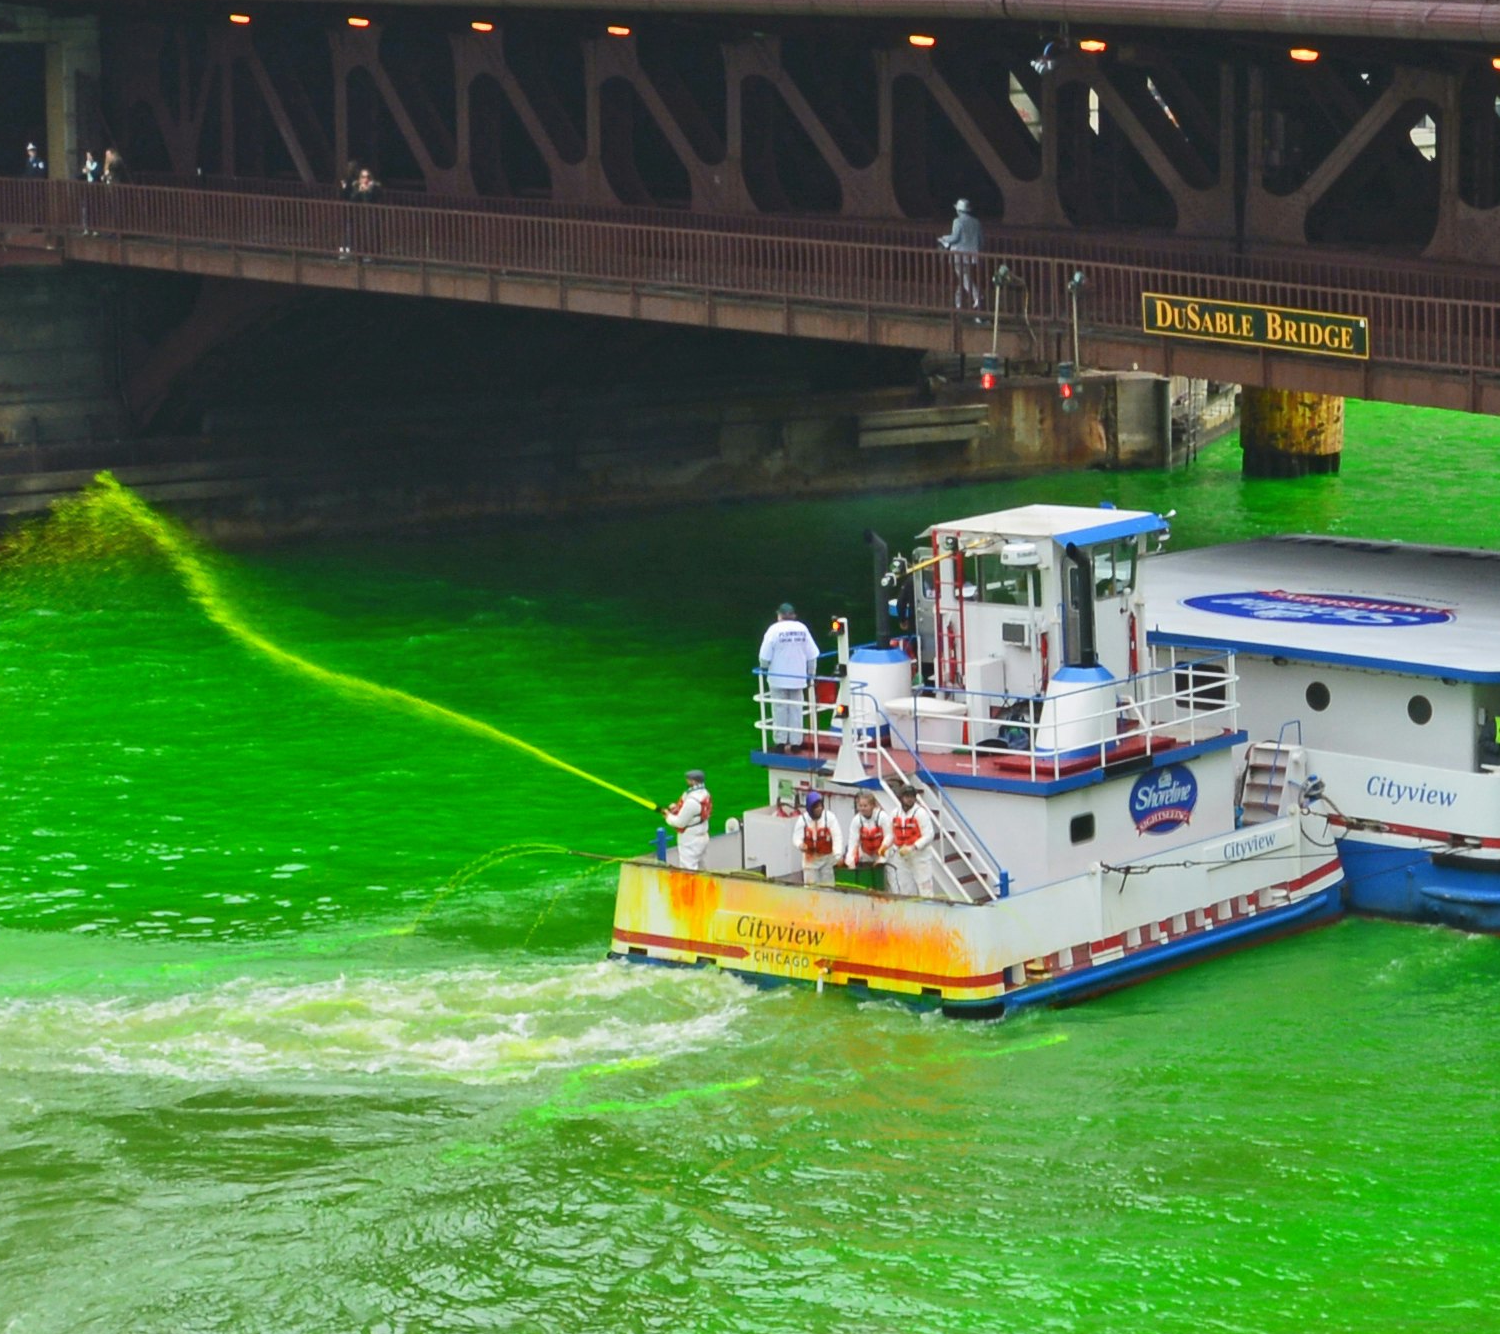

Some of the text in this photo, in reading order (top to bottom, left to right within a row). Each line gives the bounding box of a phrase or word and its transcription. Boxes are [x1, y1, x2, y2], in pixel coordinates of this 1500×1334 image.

[1134, 779, 1192, 812] Shoreline
[1366, 774, 1457, 807] Cityview
[1222, 830, 1276, 861] Cityview
[736, 914, 825, 947] Cityview
[753, 949, 810, 968] CHICAGO
